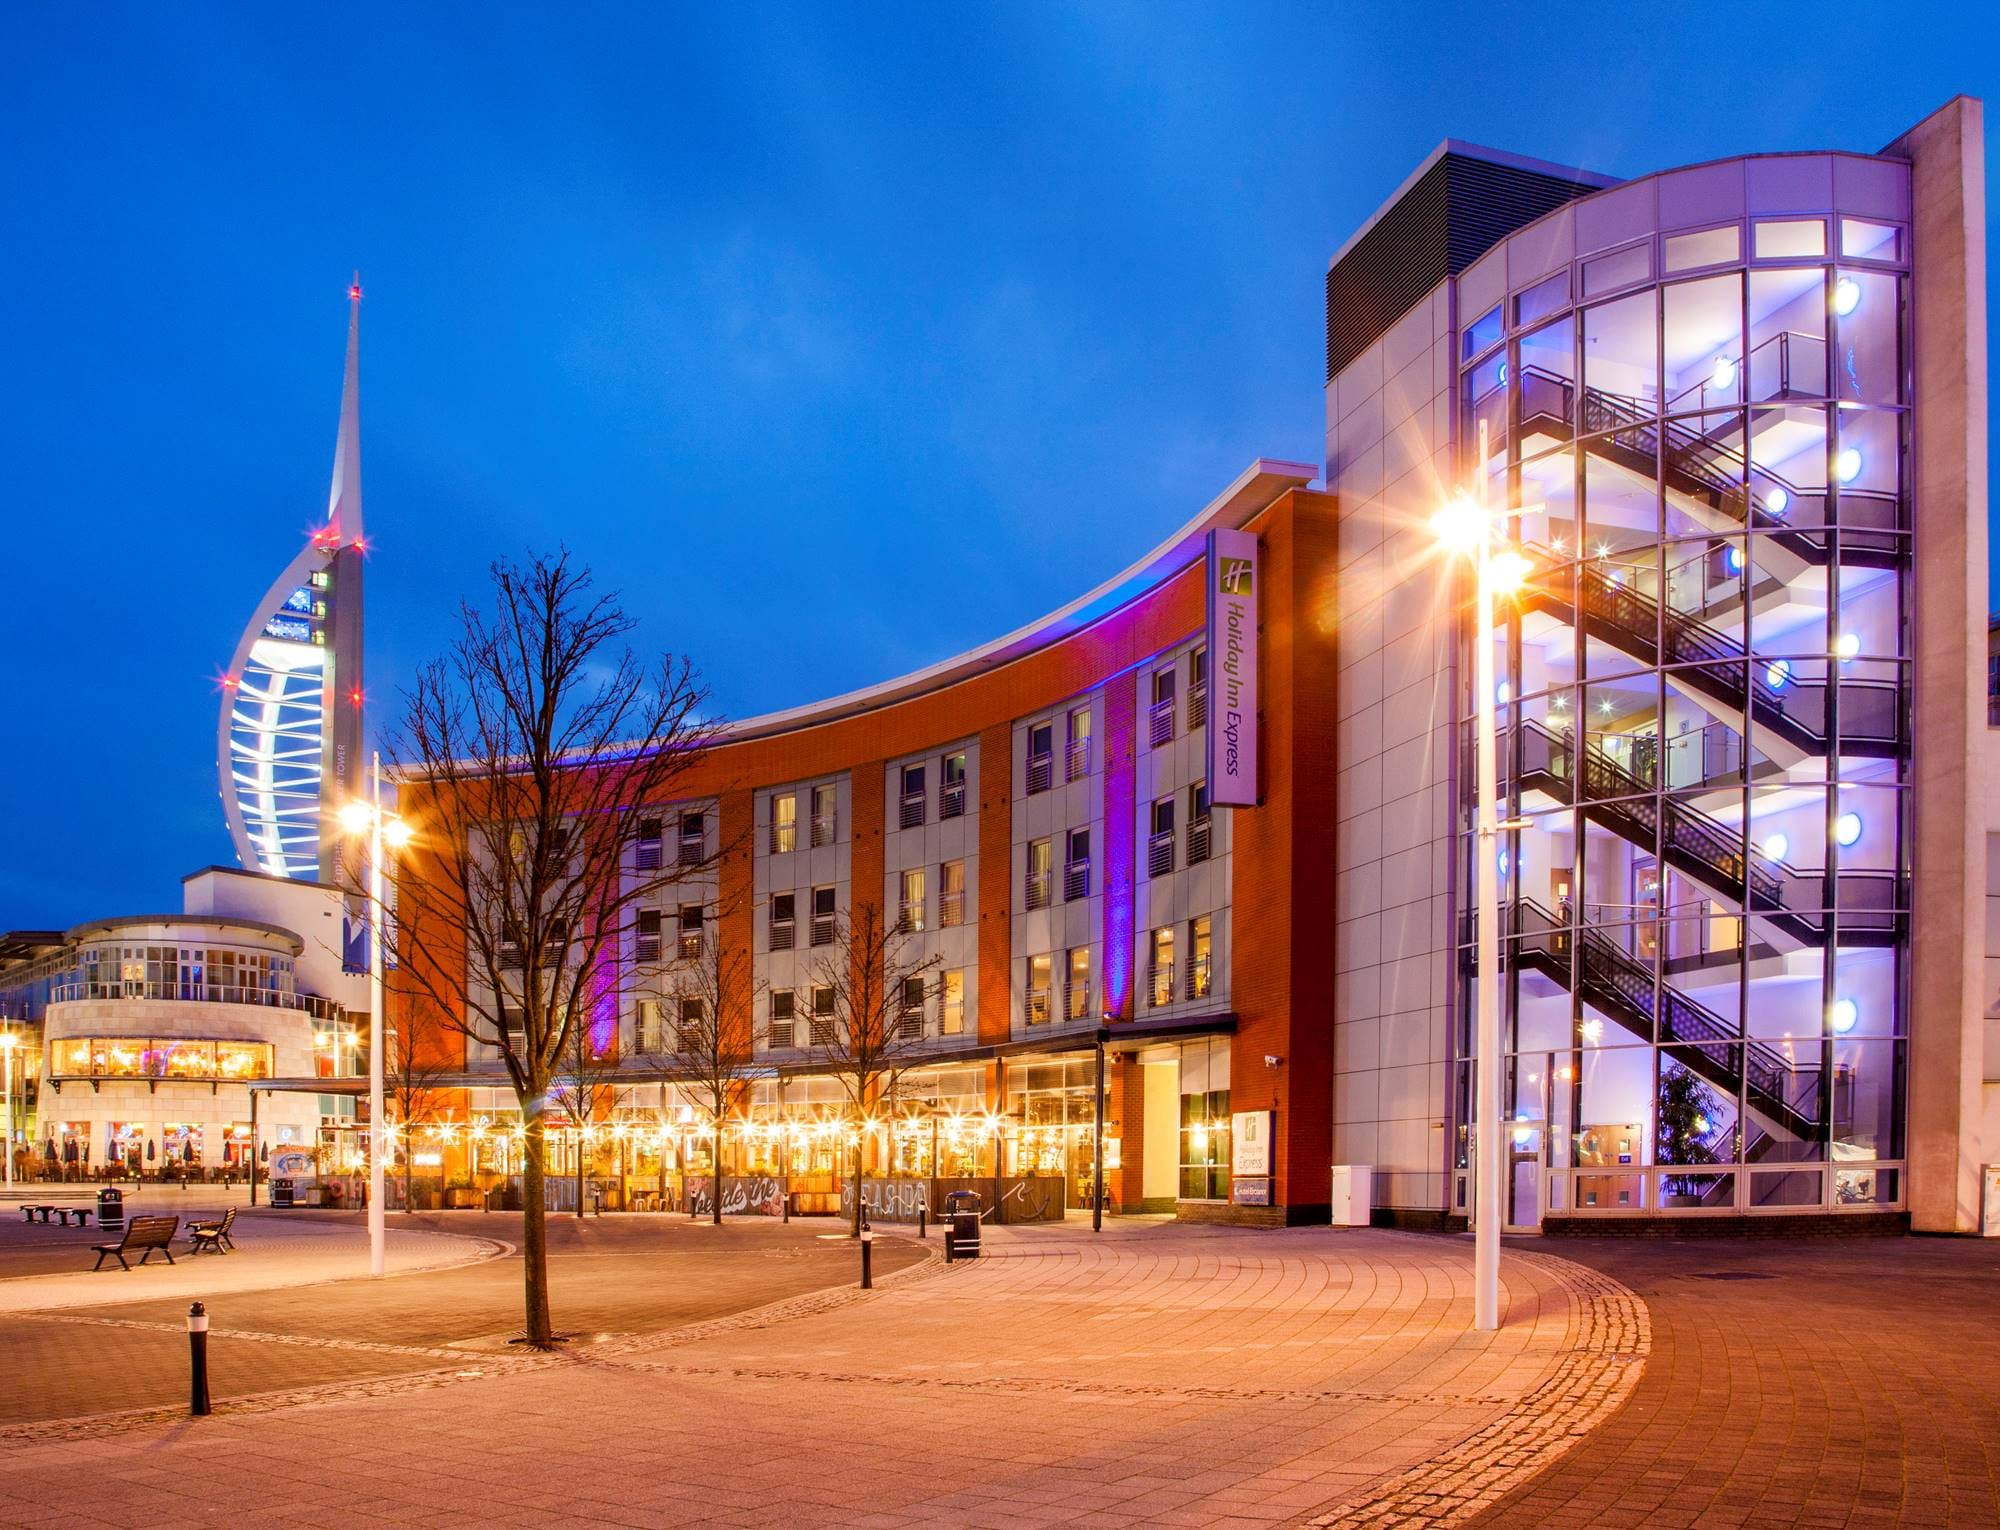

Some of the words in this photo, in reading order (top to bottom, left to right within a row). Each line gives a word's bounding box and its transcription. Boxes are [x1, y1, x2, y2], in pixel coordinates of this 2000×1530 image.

[1222, 601, 1246, 675] Holiday
[1226, 677, 1245, 708] Inn
[335, 744, 346, 775] TOWER
[1222, 711, 1243, 777] Express
[1238, 1156, 1263, 1171] Express
